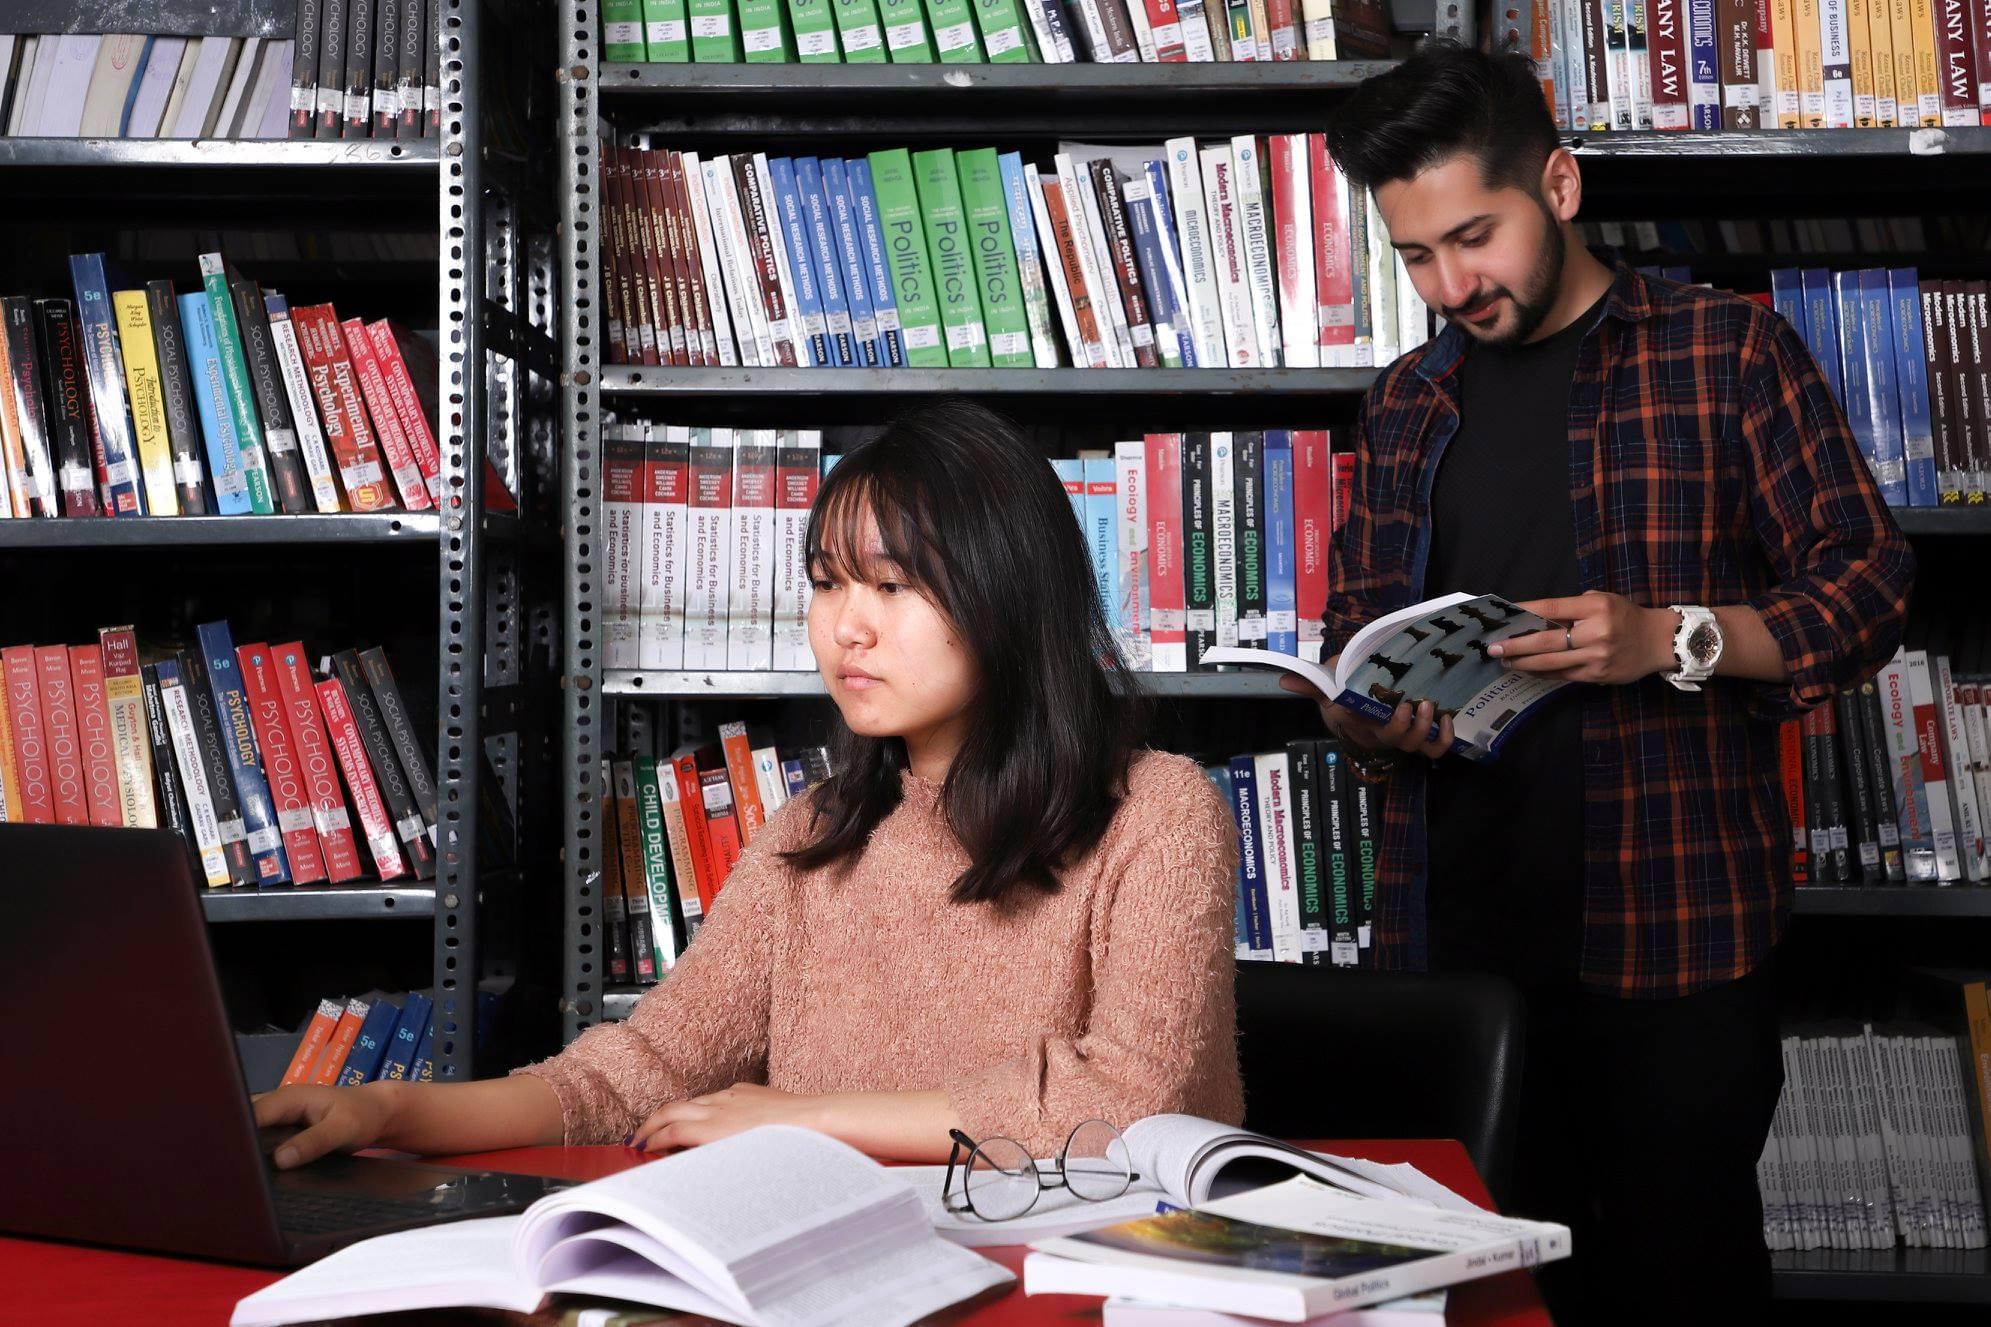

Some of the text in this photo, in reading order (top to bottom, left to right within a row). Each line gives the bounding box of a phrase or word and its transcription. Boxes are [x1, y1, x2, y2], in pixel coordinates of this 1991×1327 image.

[1697, 60, 1711, 74] 7th
[1828, 13, 1840, 57] BUSINESS
[1660, 50, 1678, 96] LAW
[1833, 70, 1843, 78] 6e
[1949, 51, 1969, 99] LAW
[744, 162, 766, 233] COMPARATIVE
[759, 234, 776, 281] POLITICS
[783, 193, 813, 300] SOCIAL RESEARCH METHODS
[809, 192, 839, 299] SOCIAL RESEARCH METHODS
[1058, 218, 1083, 285] The Republic
[1101, 166, 1125, 237] COMPARATIVE
[1119, 237, 1137, 285] POLITICS
[1185, 210, 1206, 283] MICROECONOMICS
[1210, 190, 1225, 258] THEORY AND POLICY
[1216, 162, 1241, 283] Modern Macroeconomics
[1246, 202, 1270, 301] MACROECONOMICS
[1323, 223, 1335, 278] ECONOMICS
[83, 290, 101, 301] 5e
[714, 206, 745, 319] International Relations Today
[890, 220, 922, 304] Politics
[936, 220, 966, 304] Politics
[978, 220, 1008, 304] Politics
[1923, 293, 1936, 362] Microeconomics
[1933, 292, 1942, 326] Modern
[1946, 294, 1960, 363] Microeconomics
[1957, 293, 1966, 327] Modern
[1967, 295, 1981, 363] Microeconomics
[1978, 293, 1987, 328] Modern
[57, 322, 80, 419] PSYCHOLOGY
[160, 324, 190, 435] SOCIAL PSYCHOLOGY
[250, 325, 281, 430] SOCIAL PSYCHOLOG
[280, 322, 316, 429] RESEARCH METHODOLOGY
[888, 332, 898, 363] PEARSON
[133, 367, 155, 444] PSYCHOLOGY
[147, 377, 161, 433] Introduction to
[313, 365, 344, 437] Psychology
[333, 361, 374, 449] Experimental
[389, 359, 419, 420] CONTEMPORARY
[1127, 469, 1138, 524] Ecology
[607, 509, 617, 585] and Economics
[620, 509, 631, 556] Statistics
[620, 558, 629, 572] for
[651, 510, 663, 586] and Economics
[663, 510, 675, 621] Statistics for Business
[695, 514, 707, 590] and Economics
[709, 515, 720, 562] Statistics
[738, 514, 749, 590] and Economics
[1098, 517, 1109, 569] Business
[1157, 521, 1167, 577] ECONOMICS
[1191, 478, 1205, 601] PRINCIPLES OF ECONOMICS
[1217, 500, 1233, 599] MACROECONOMICS
[1243, 477, 1259, 600] PRINCIPLES OF ECONOMICS
[1304, 519, 1314, 575] ECONOMICS
[618, 574, 629, 620] Business
[707, 579, 718, 626] Business
[709, 564, 718, 578] for
[749, 514, 762, 625] Statistics for Business
[108, 640, 129, 650] Hall
[214, 659, 230, 670] 5e
[255, 666, 266, 692] Pearson
[289, 666, 300, 692] Pearson
[113, 704, 130, 756] MEDICAL
[146, 683, 161, 746] Mahatma Gandhi
[227, 690, 256, 767] PSYCHOLOGY
[1466, 674, 1522, 718] Political
[1888, 673, 1905, 728] Ecology
[1949, 718, 1959, 741] LAWS
[14, 682, 46, 808] PSYCHOLOGY
[47, 680, 79, 806] PSYCHOLOGY
[82, 684, 112, 808] PSYCHOLOGY
[126, 702, 139, 734] Guyton
[133, 743, 142, 761] Hall
[172, 688, 205, 796] RESEARCH METHODOLOGY
[196, 692, 230, 802] SOCIAL PSYCHOLOGY
[356, 692, 405, 799] SOCIAL PSYCHOLOGY
[382, 691, 431, 796] SOCIAL PSYCHOLOGY
[1918, 734, 1927, 753] Law
[1927, 720, 1939, 765] Company
[641, 783, 660, 830] CHILD
[1234, 770, 1250, 779] 11e
[1852, 748, 1868, 812] Corporate Laws
[1872, 748, 1889, 812] Corporate Laws
[674, 808, 695, 892] PROGRAMMING
[1239, 788, 1256, 880] MACROECONOMICS
[1269, 768, 1293, 890] Modern Macroeconomics
[1300, 789, 1318, 913] PRINCIPLES OF ECONOMICS
[1330, 799, 1349, 923] PRINCIPLES OF ECONOMICS
[360, 1035, 376, 1050] 5e
